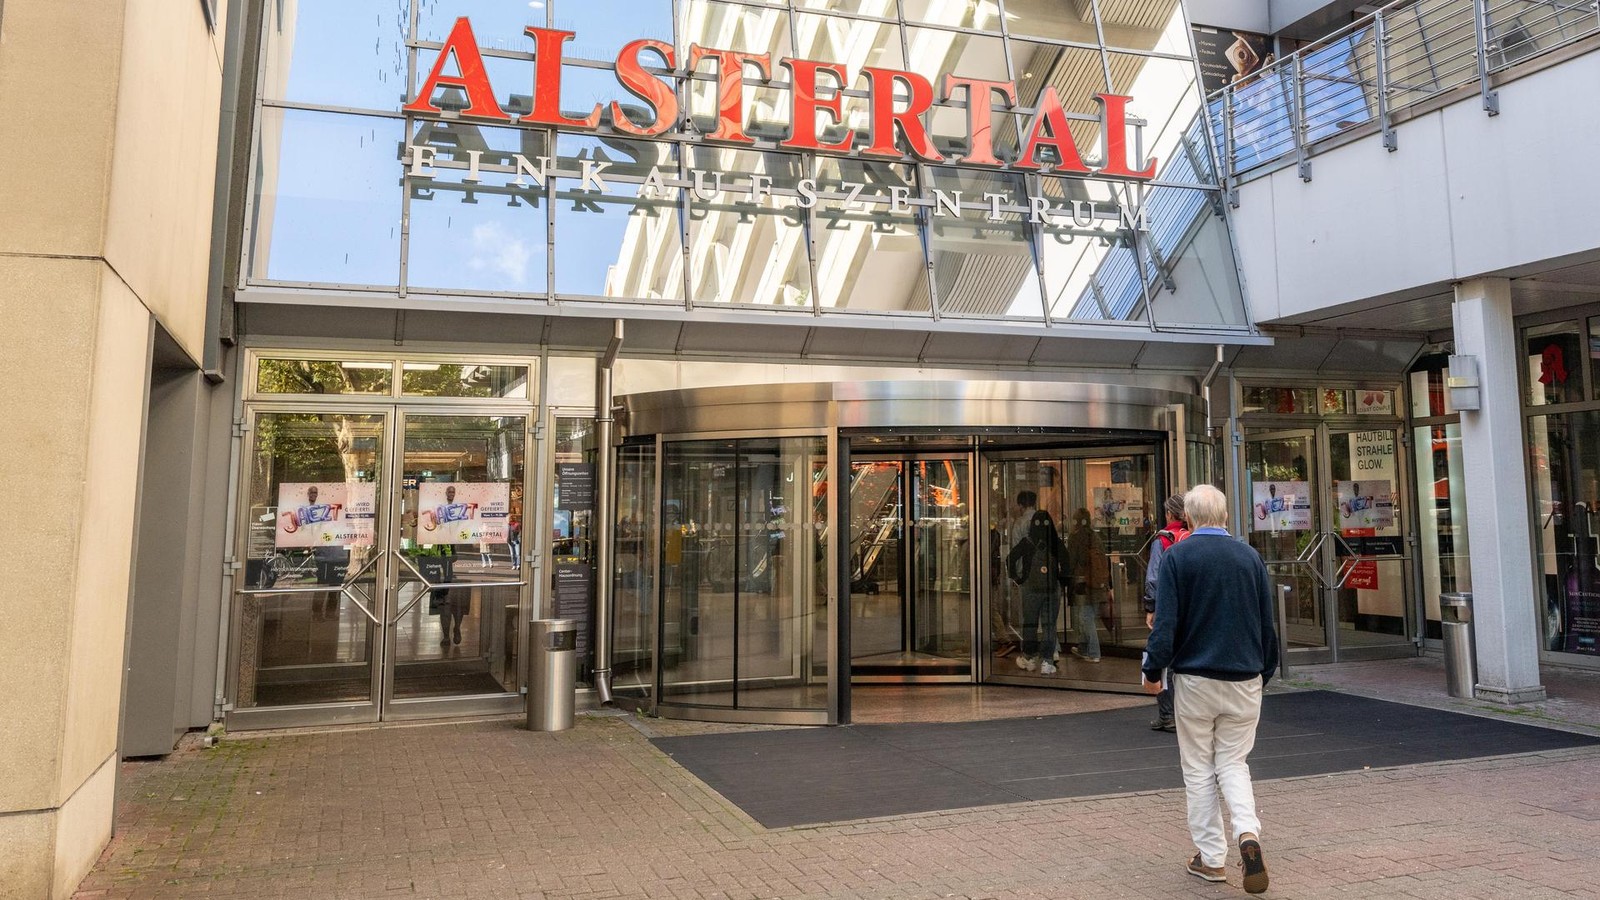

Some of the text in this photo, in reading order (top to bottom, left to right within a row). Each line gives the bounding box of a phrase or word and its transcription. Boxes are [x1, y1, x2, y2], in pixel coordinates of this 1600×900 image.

[402, 16, 1157, 180] ALSTERTAL
[408, 145, 1151, 232] EINKAUFSZENTRUM
[1358, 460, 1384, 470] GLOW.
